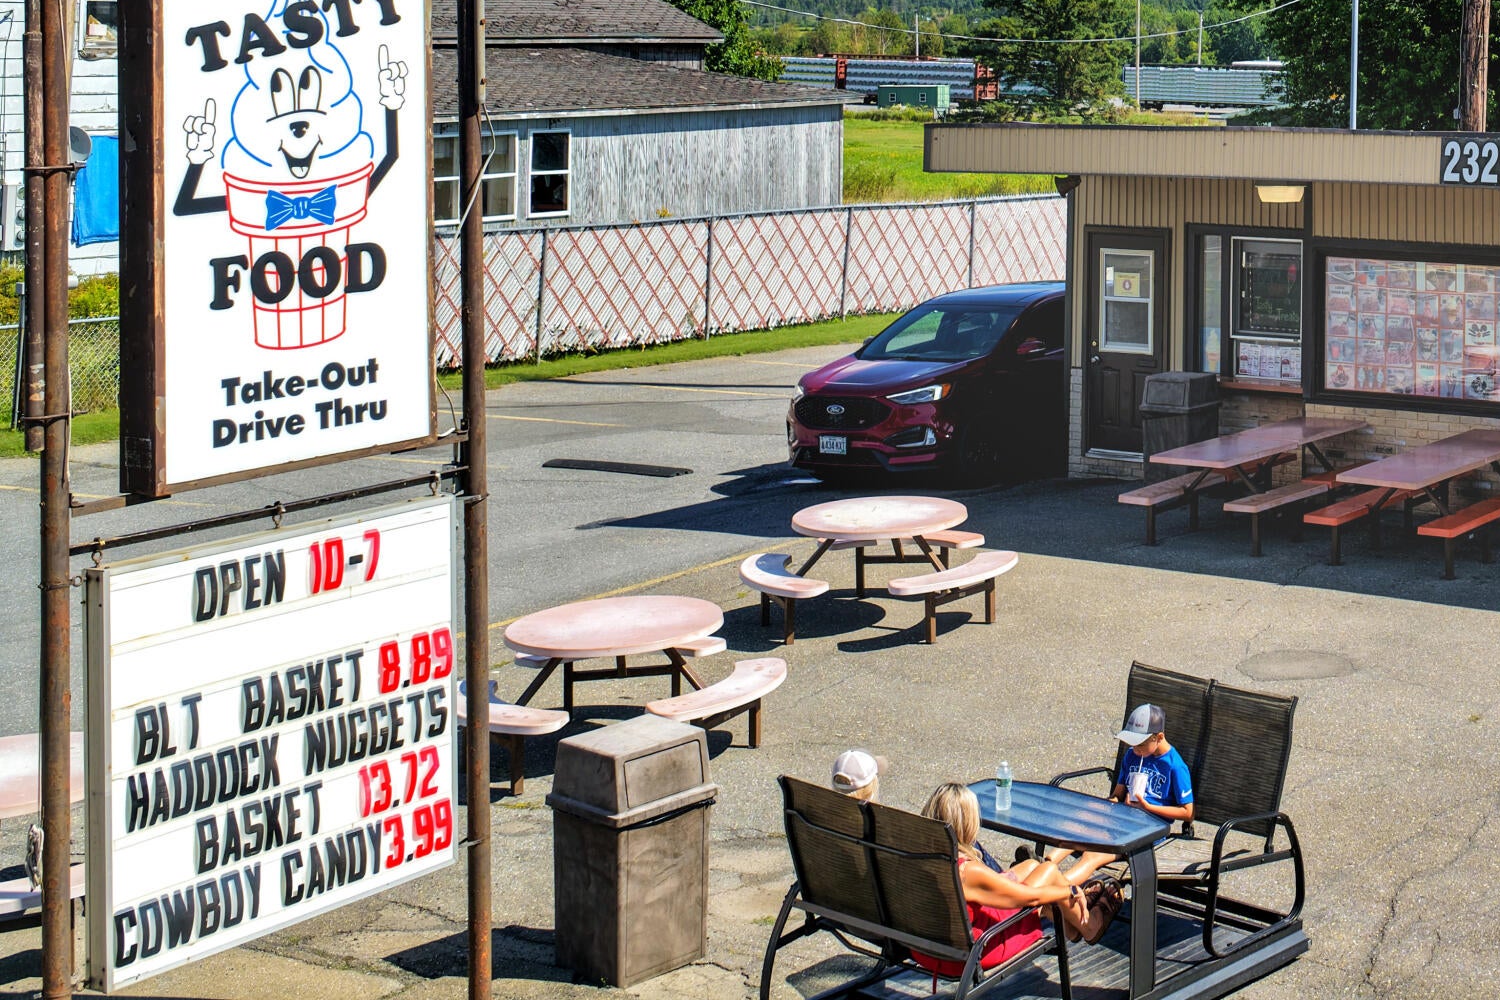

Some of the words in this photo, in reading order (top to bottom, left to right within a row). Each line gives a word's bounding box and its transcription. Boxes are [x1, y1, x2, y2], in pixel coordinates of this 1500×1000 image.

[1443, 141, 1499, 183] 232
[208, 242, 387, 310] FOOD
[212, 408, 305, 448] Drive
[315, 395, 388, 428] Thru
[221, 357, 378, 407] Take-Out
[194, 549, 286, 622] OPEN
[309, 529, 381, 595] 10-7
[135, 693, 202, 765] BLT
[242, 649, 364, 733] BASKET
[378, 627, 453, 694] 8.89
[126, 733, 280, 833] HADDOCK
[304, 686, 447, 776] NUGGETS
[197, 780, 322, 874] BASKET
[358, 745, 440, 818] 13.72
[114, 862, 261, 968] COWBOY
[282, 818, 383, 906] CANDY
[383, 797, 452, 869] 3.99
